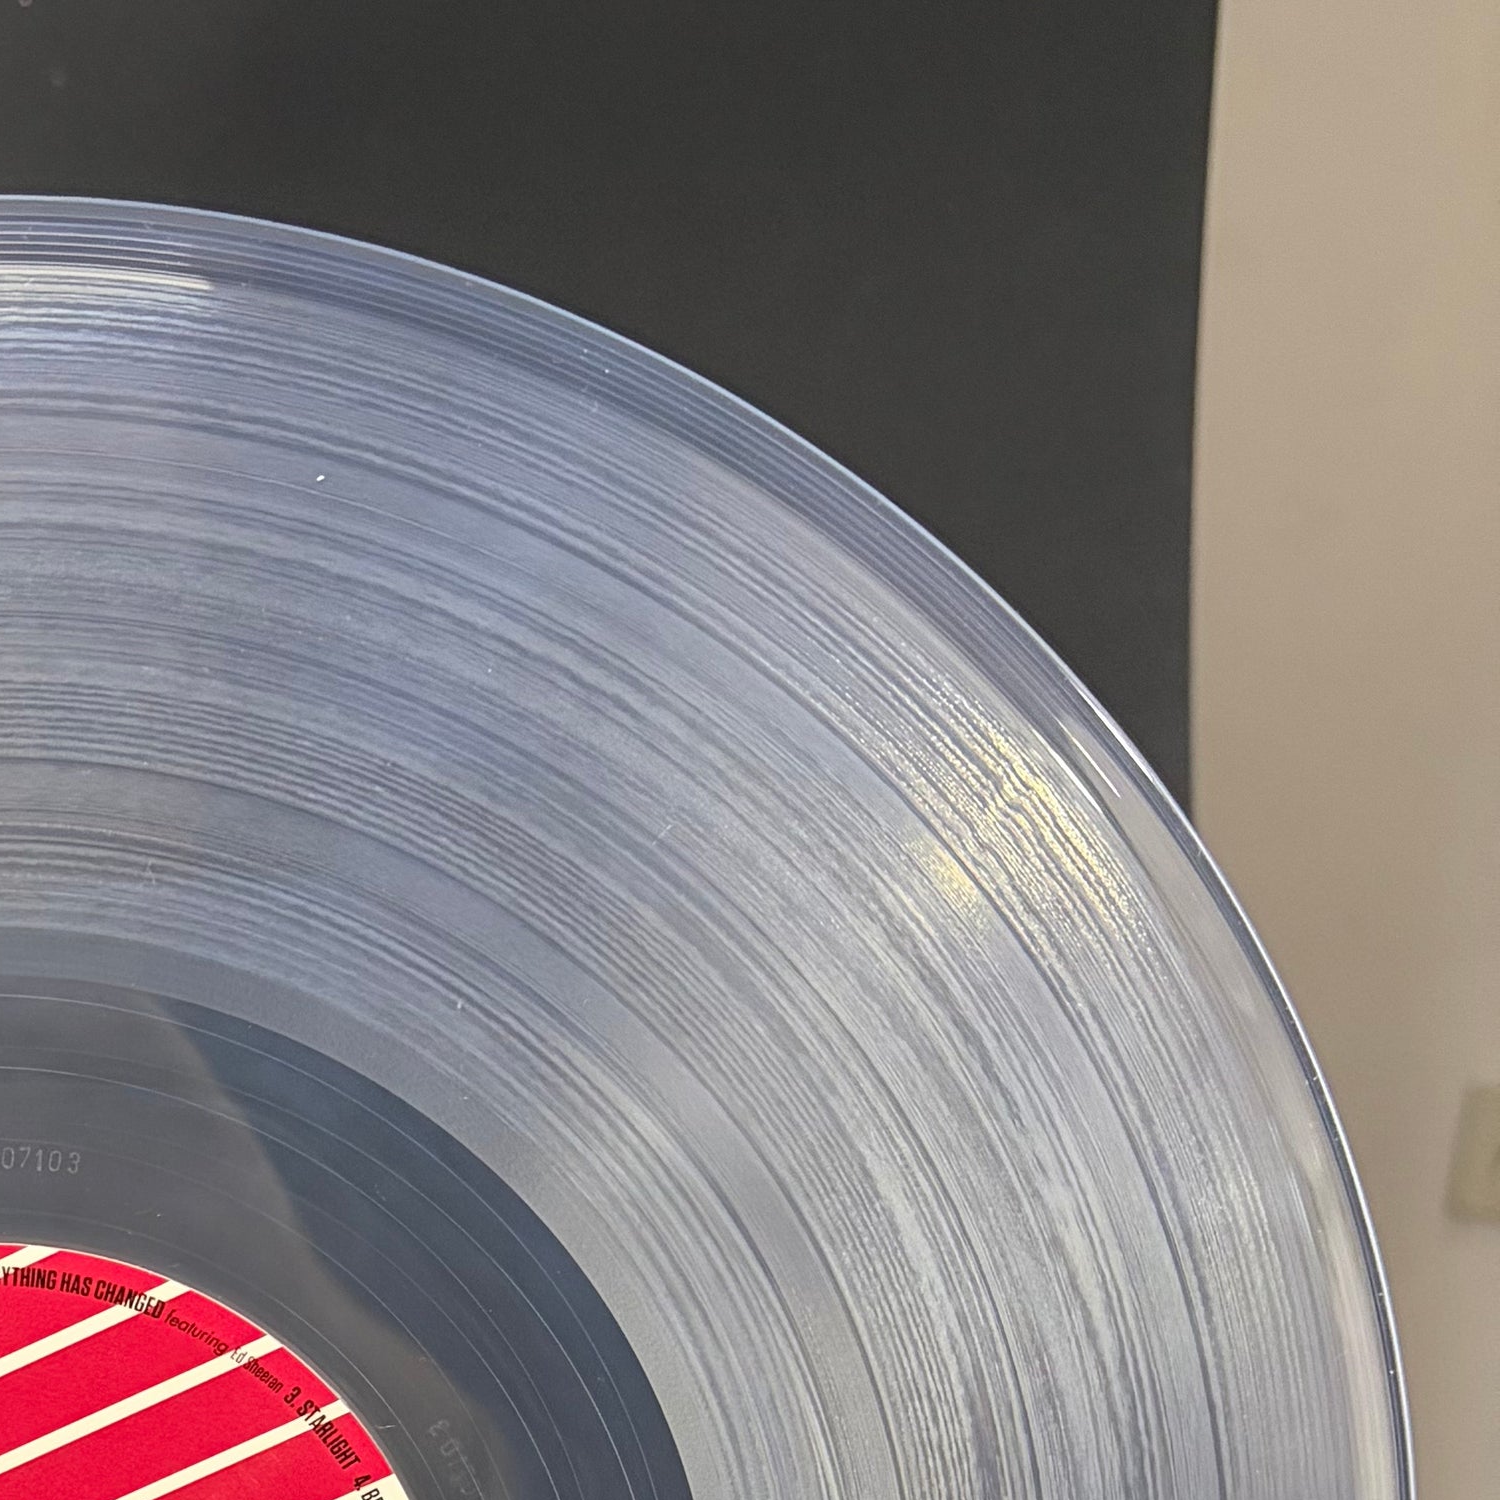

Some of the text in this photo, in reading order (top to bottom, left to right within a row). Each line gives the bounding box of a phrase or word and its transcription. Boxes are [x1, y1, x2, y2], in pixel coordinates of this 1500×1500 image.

[59, 1271, 91, 1297] HAS
[93, 1279, 166, 1320] CHANGED
[164, 1309, 229, 1357] featuring
[230, 1347, 248, 1364] Ed
[242, 1356, 284, 1394] Sheeran
[283, 1386, 302, 1408] 3.
[296, 1399, 361, 1470] STARLIGHT
[353, 1474, 371, 1491] 4.
